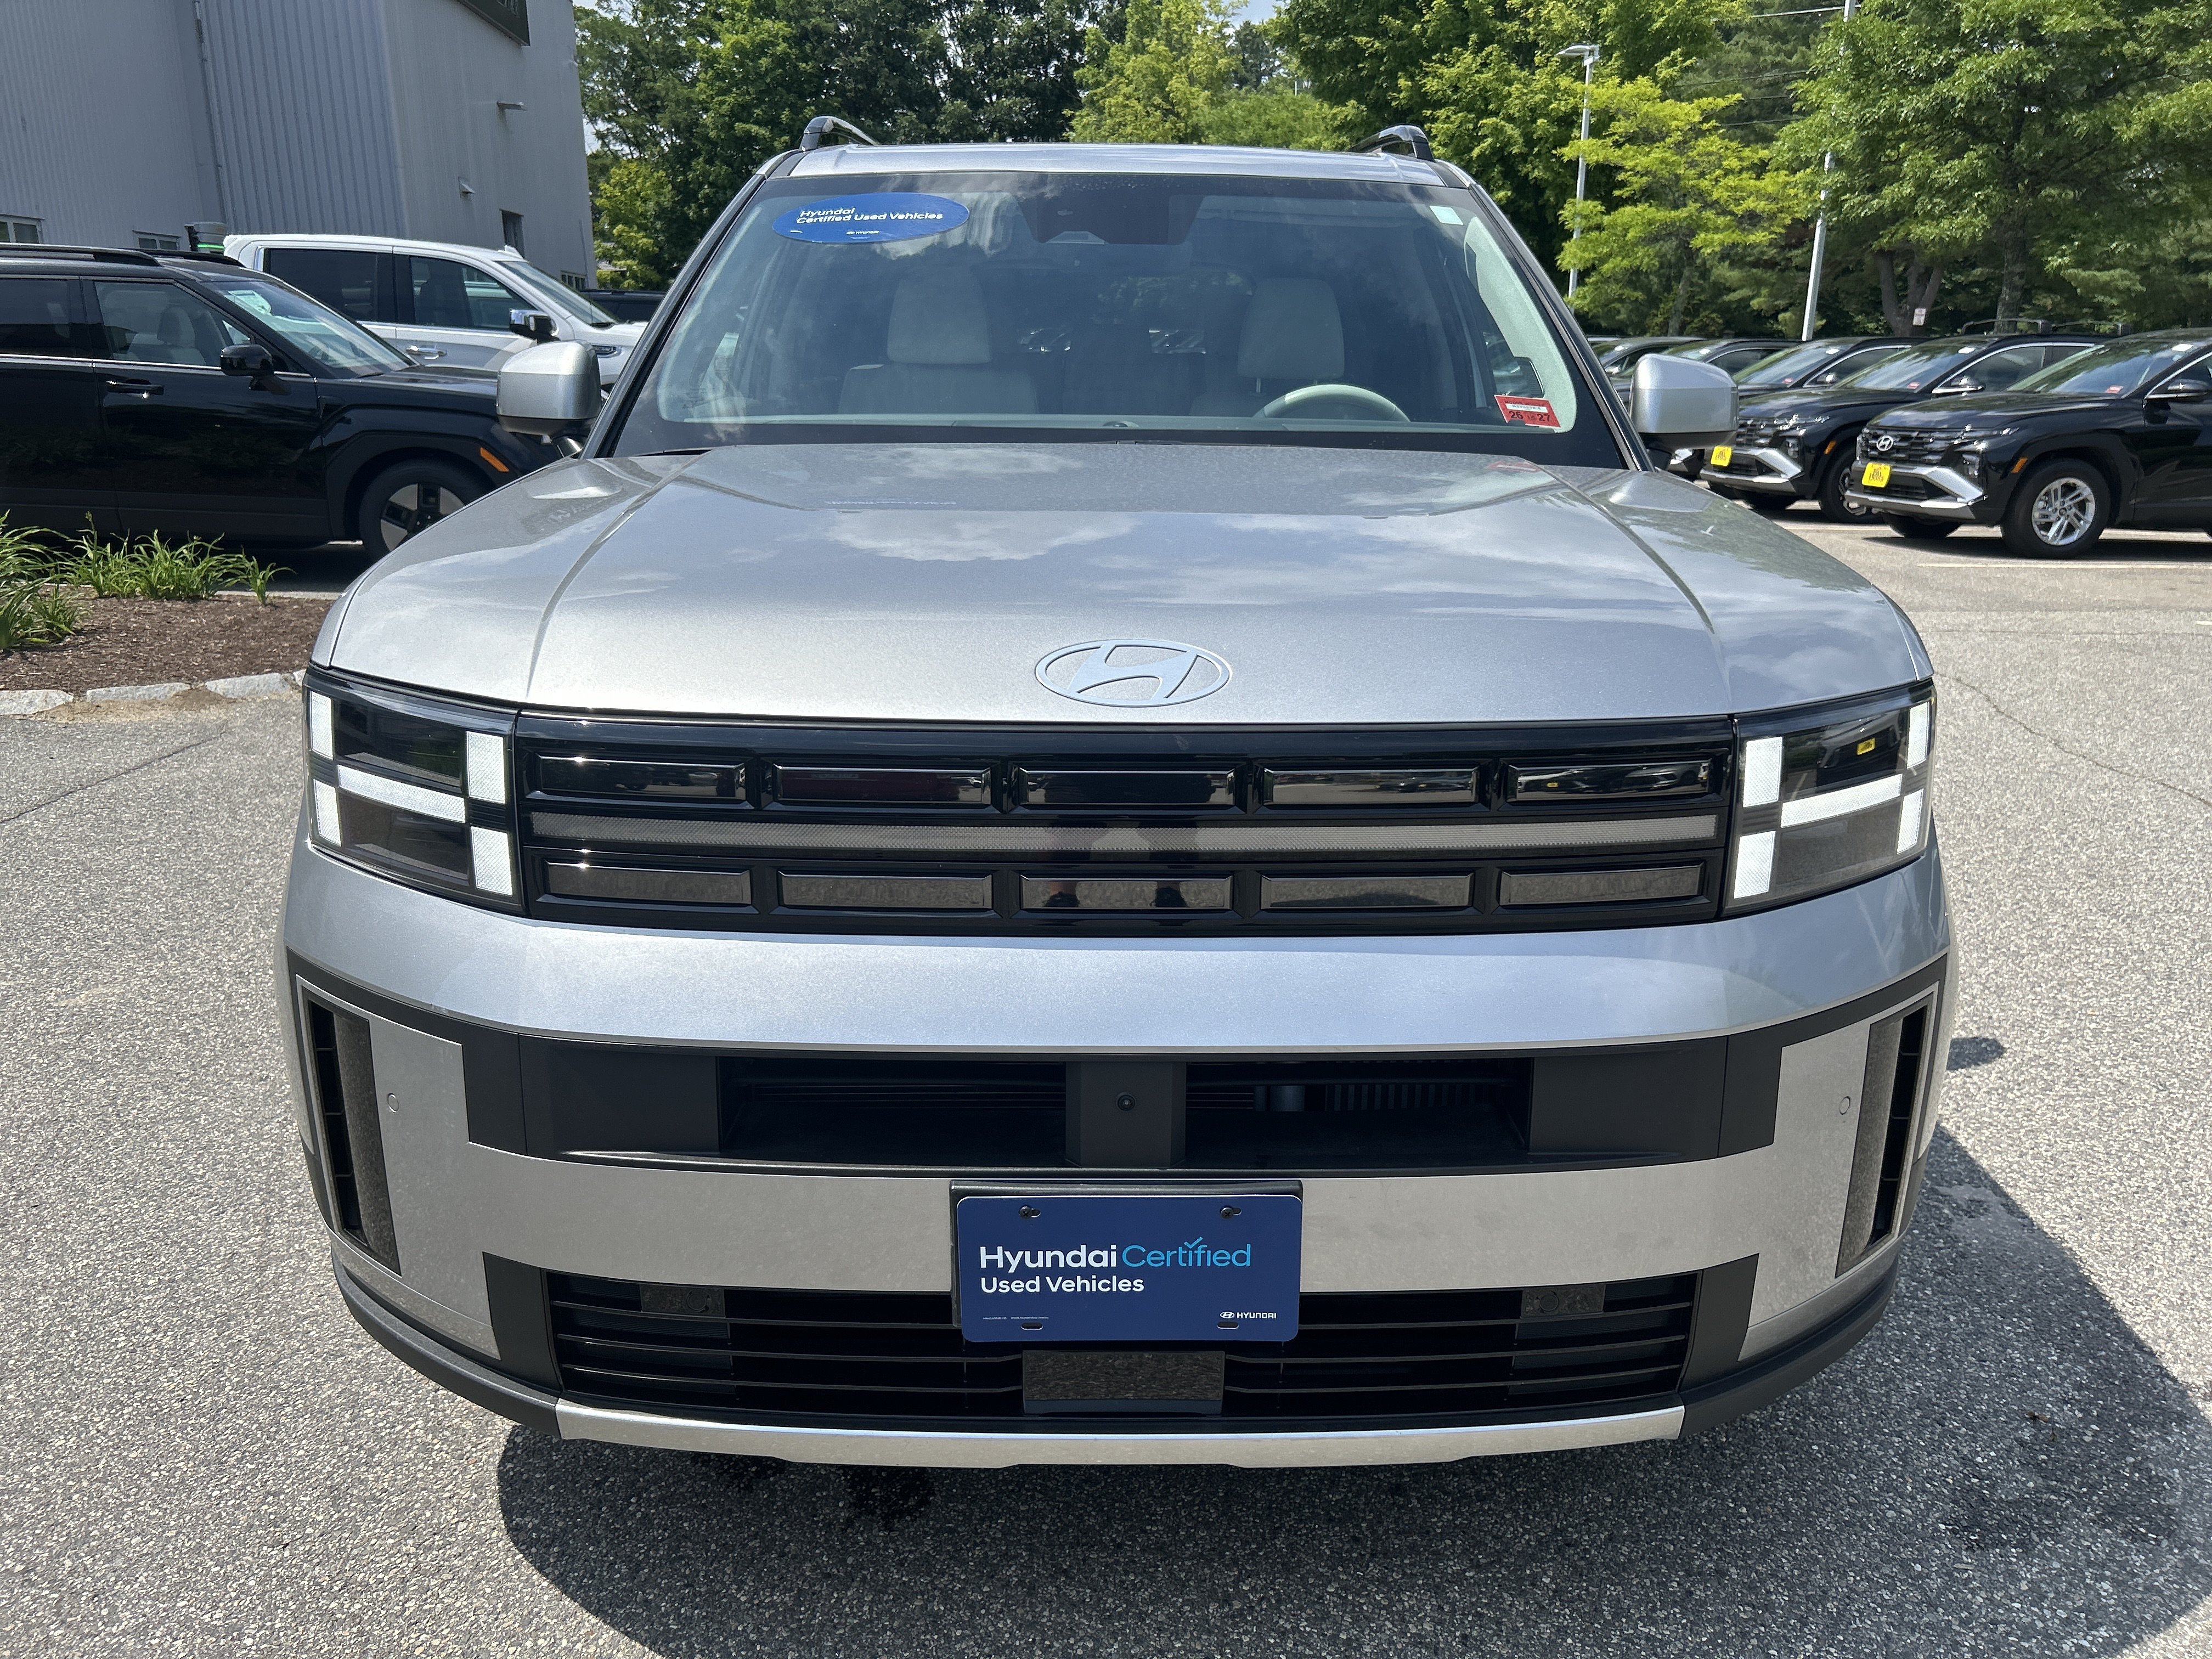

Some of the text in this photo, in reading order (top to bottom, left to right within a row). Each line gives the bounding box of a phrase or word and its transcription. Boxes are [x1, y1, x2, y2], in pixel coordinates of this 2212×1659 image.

[800, 207, 855, 217] Hyundai
[796, 215, 851, 224] Certified
[1509, 411, 1523, 419] 26
[980, 1237, 1251, 1273] Hyundai Certified
[981, 1276, 1144, 1293] Used Vehicles
